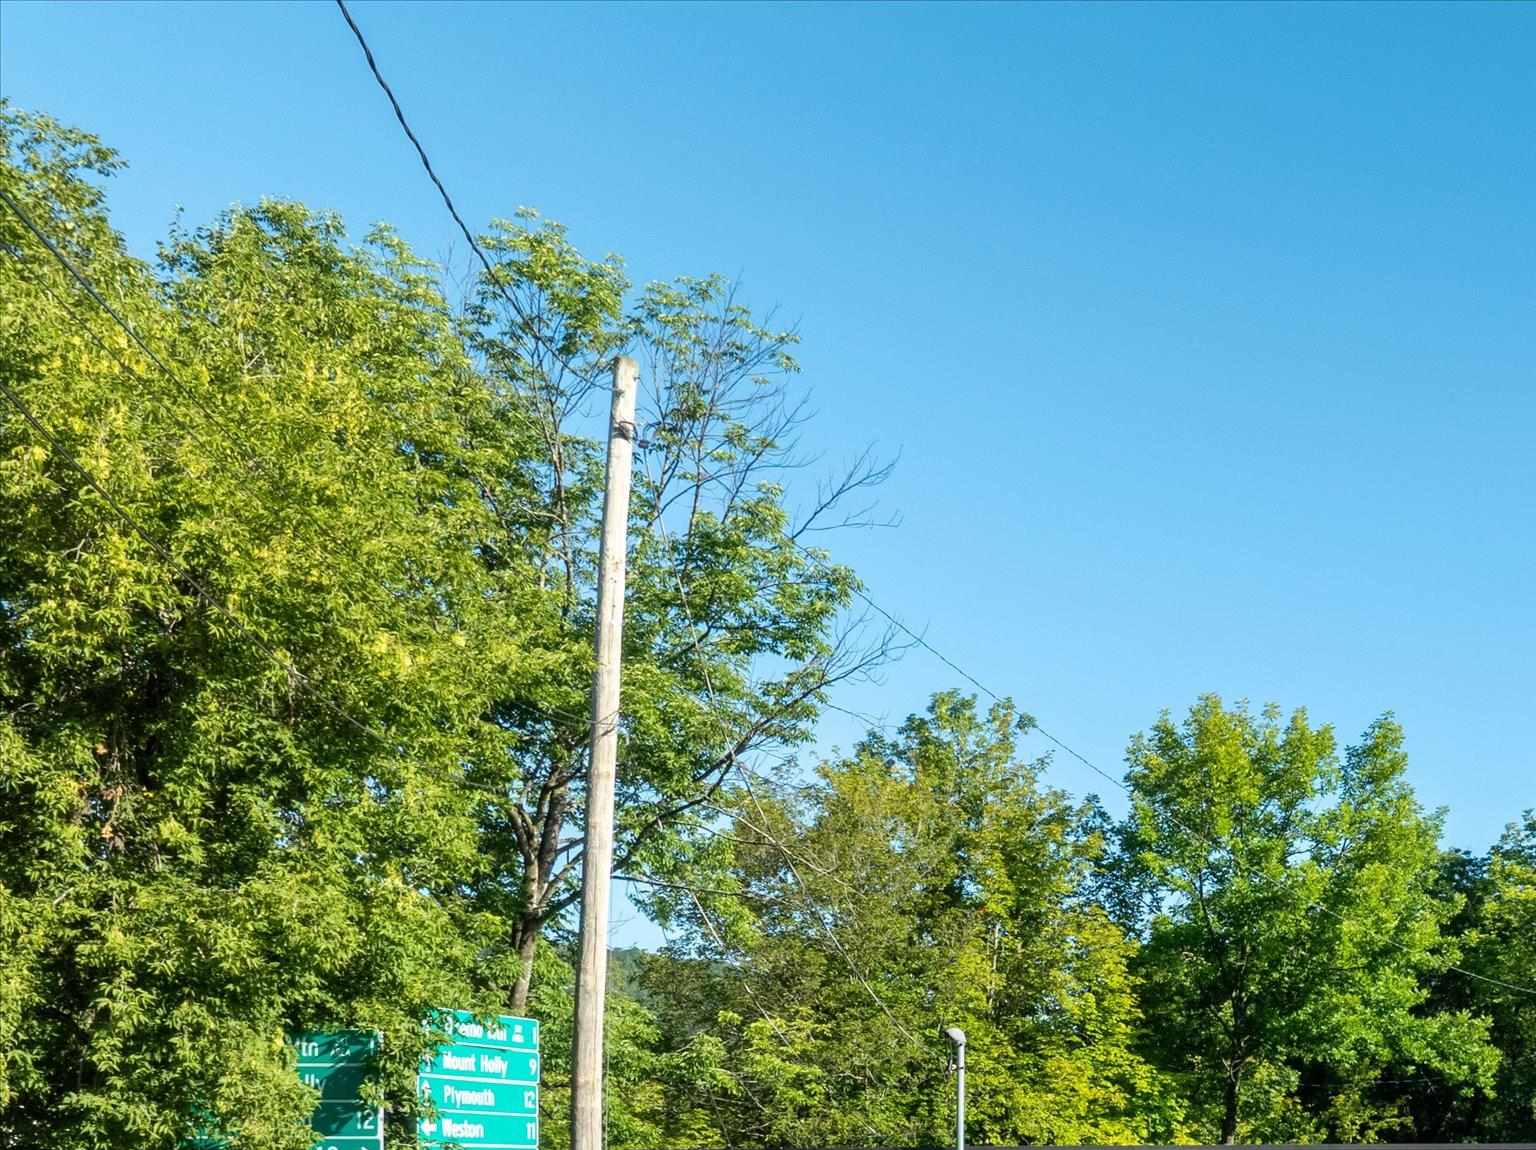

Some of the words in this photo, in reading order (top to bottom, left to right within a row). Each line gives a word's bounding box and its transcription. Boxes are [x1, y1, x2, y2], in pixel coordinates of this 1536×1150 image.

[442, 1051, 476, 1072] Mount
[480, 1054, 509, 1078] Holly
[529, 1058, 537, 1075] 9
[443, 1084, 495, 1108] Plymouth
[523, 1090, 536, 1109] 12
[356, 1109, 375, 1129] 12
[441, 1118, 485, 1138] Weston
[526, 1122, 536, 1140] 11
